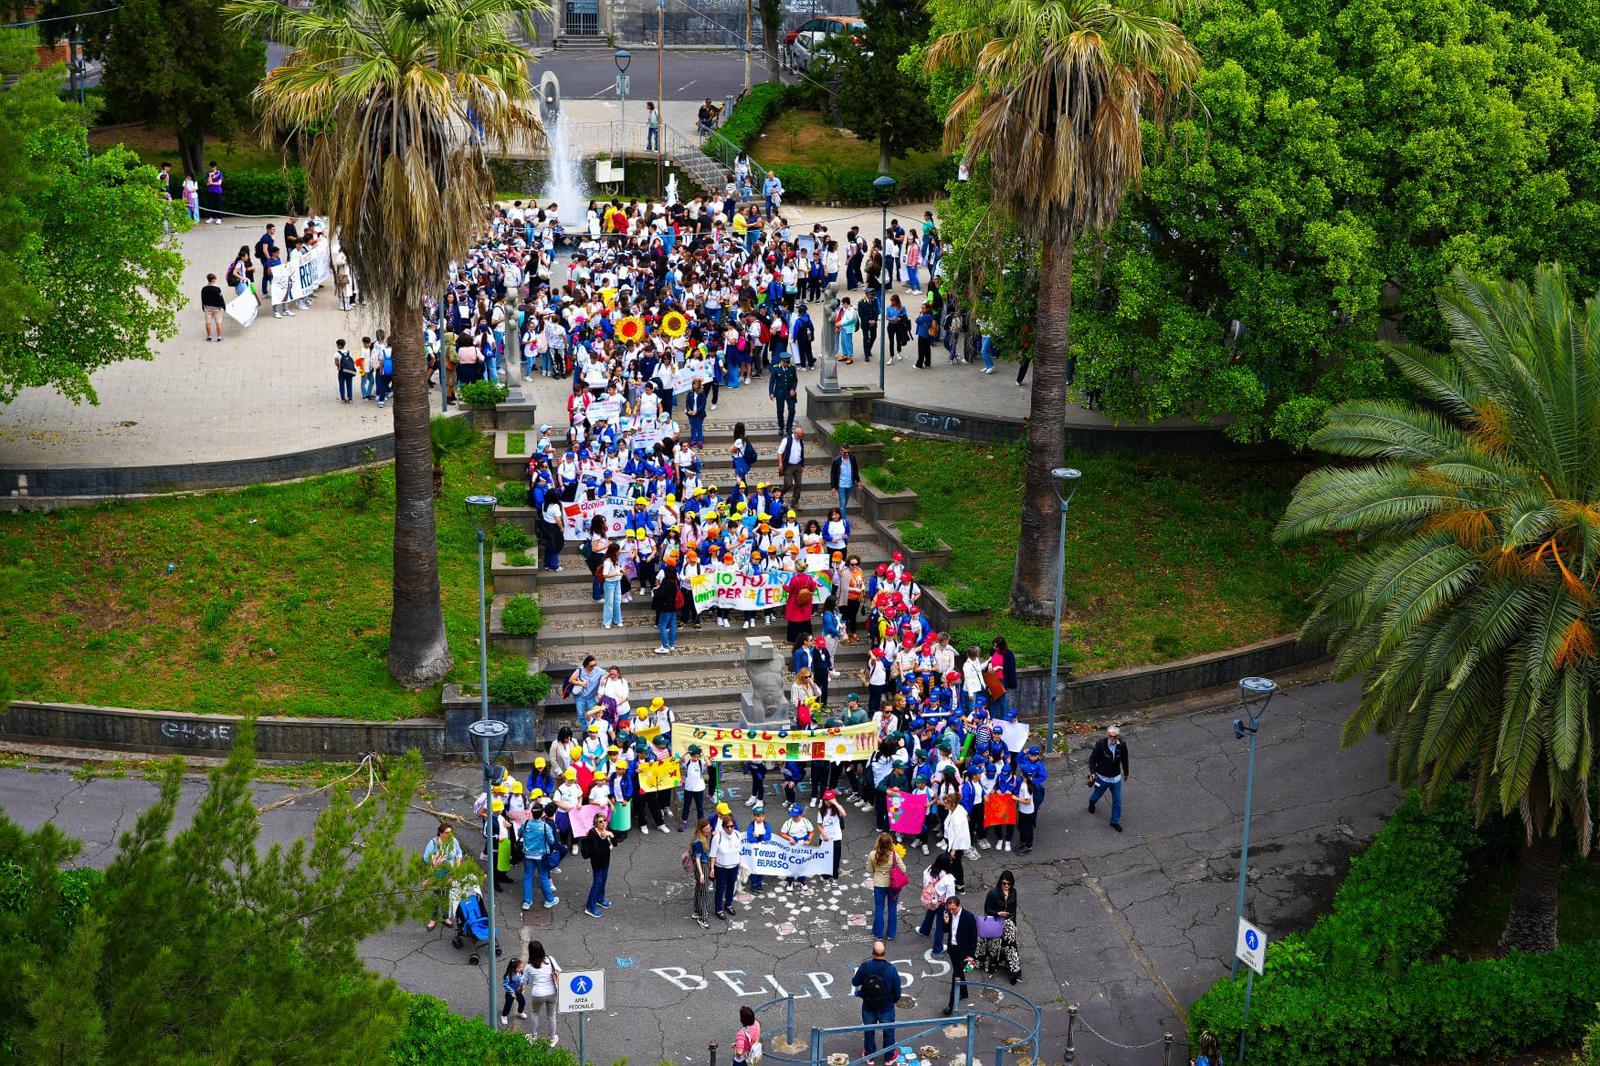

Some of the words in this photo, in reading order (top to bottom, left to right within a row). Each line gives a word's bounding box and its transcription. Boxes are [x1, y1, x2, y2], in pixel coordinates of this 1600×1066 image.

[717, 587, 742, 600] PER
[708, 742, 777, 760] DELLA
[754, 847, 775, 858] Teresa
[778, 852, 787, 861] di
